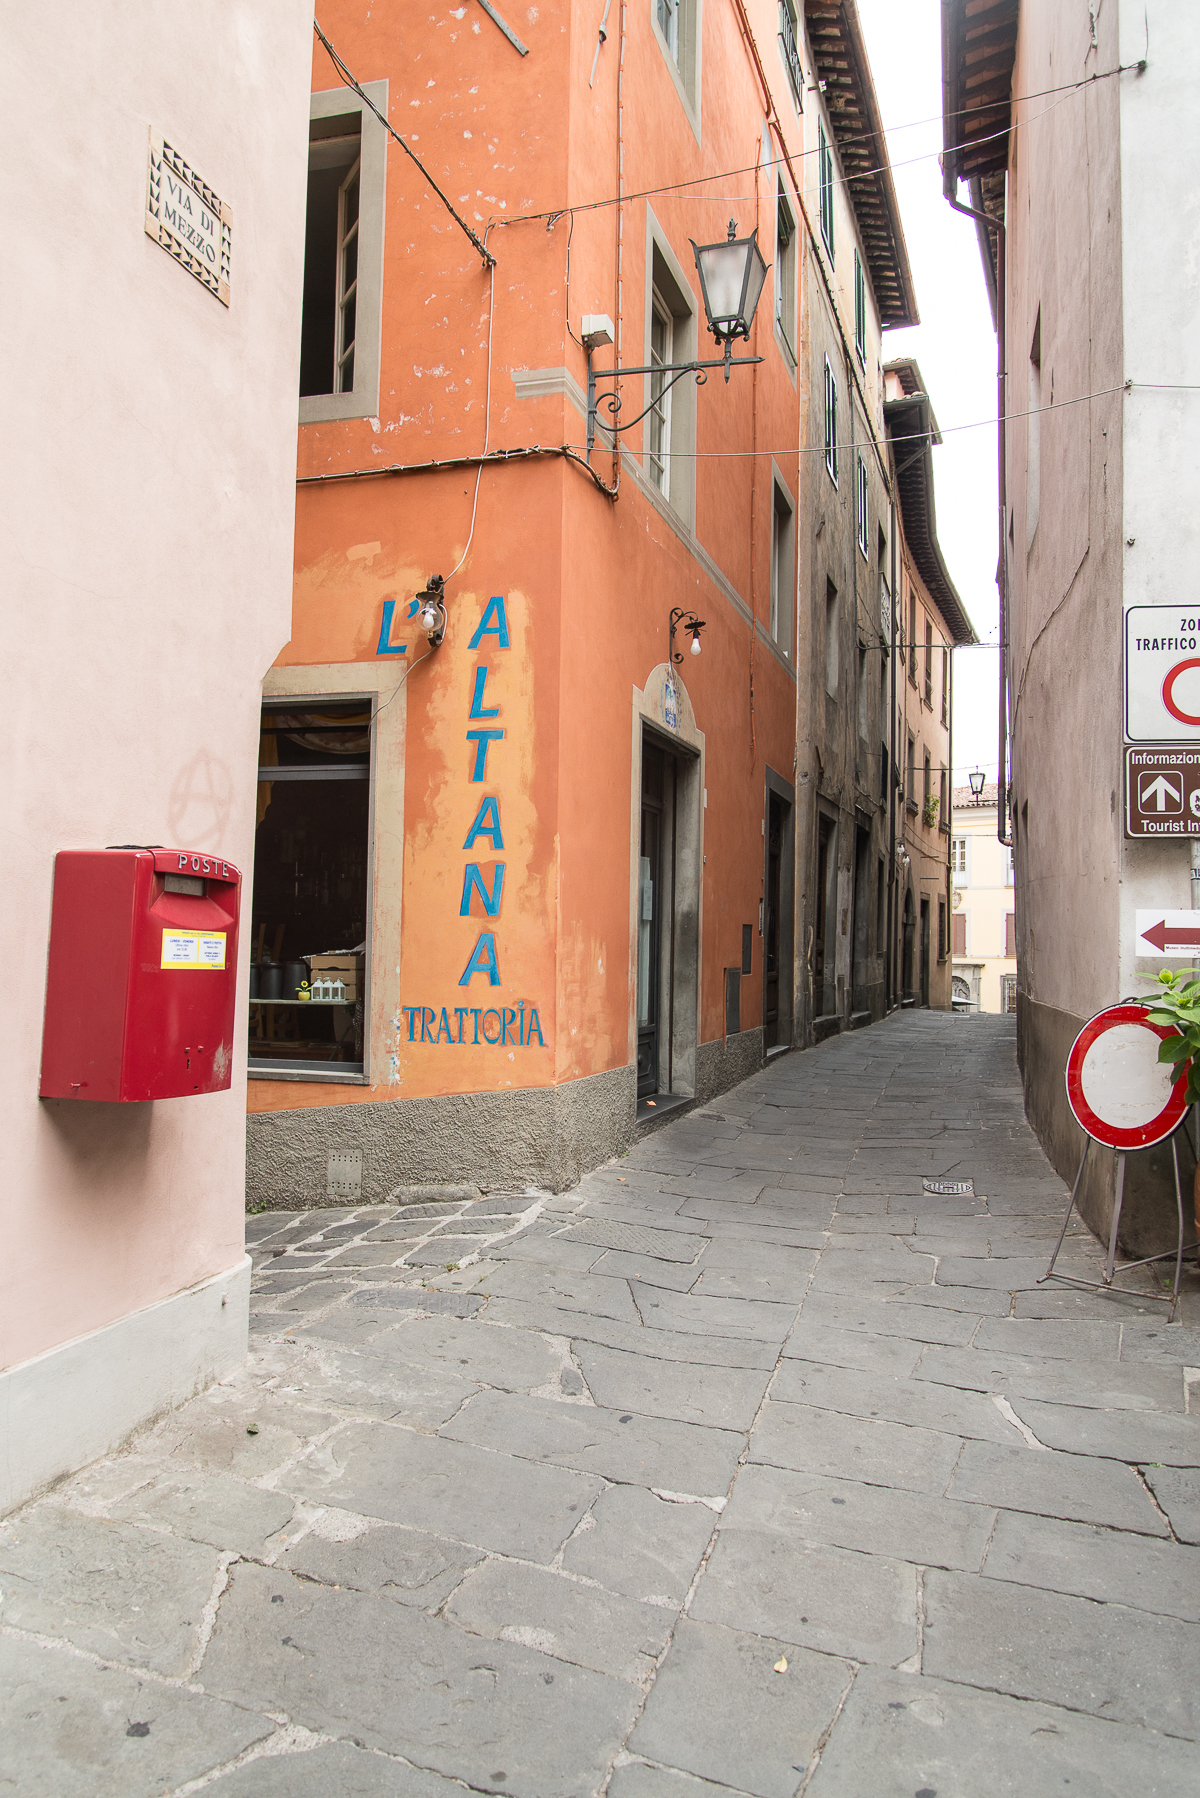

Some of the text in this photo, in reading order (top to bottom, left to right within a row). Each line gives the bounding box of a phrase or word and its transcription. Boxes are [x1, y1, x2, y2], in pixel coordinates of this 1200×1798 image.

[167, 175, 214, 236] VIA DI
[165, 201, 216, 263] MEZZO
[1135, 637, 1197, 650] TRAFFICO
[458, 596, 510, 986] ALTANA
[1141, 819, 1200, 832] Tourist In
[178, 854, 229, 877] POSTE
